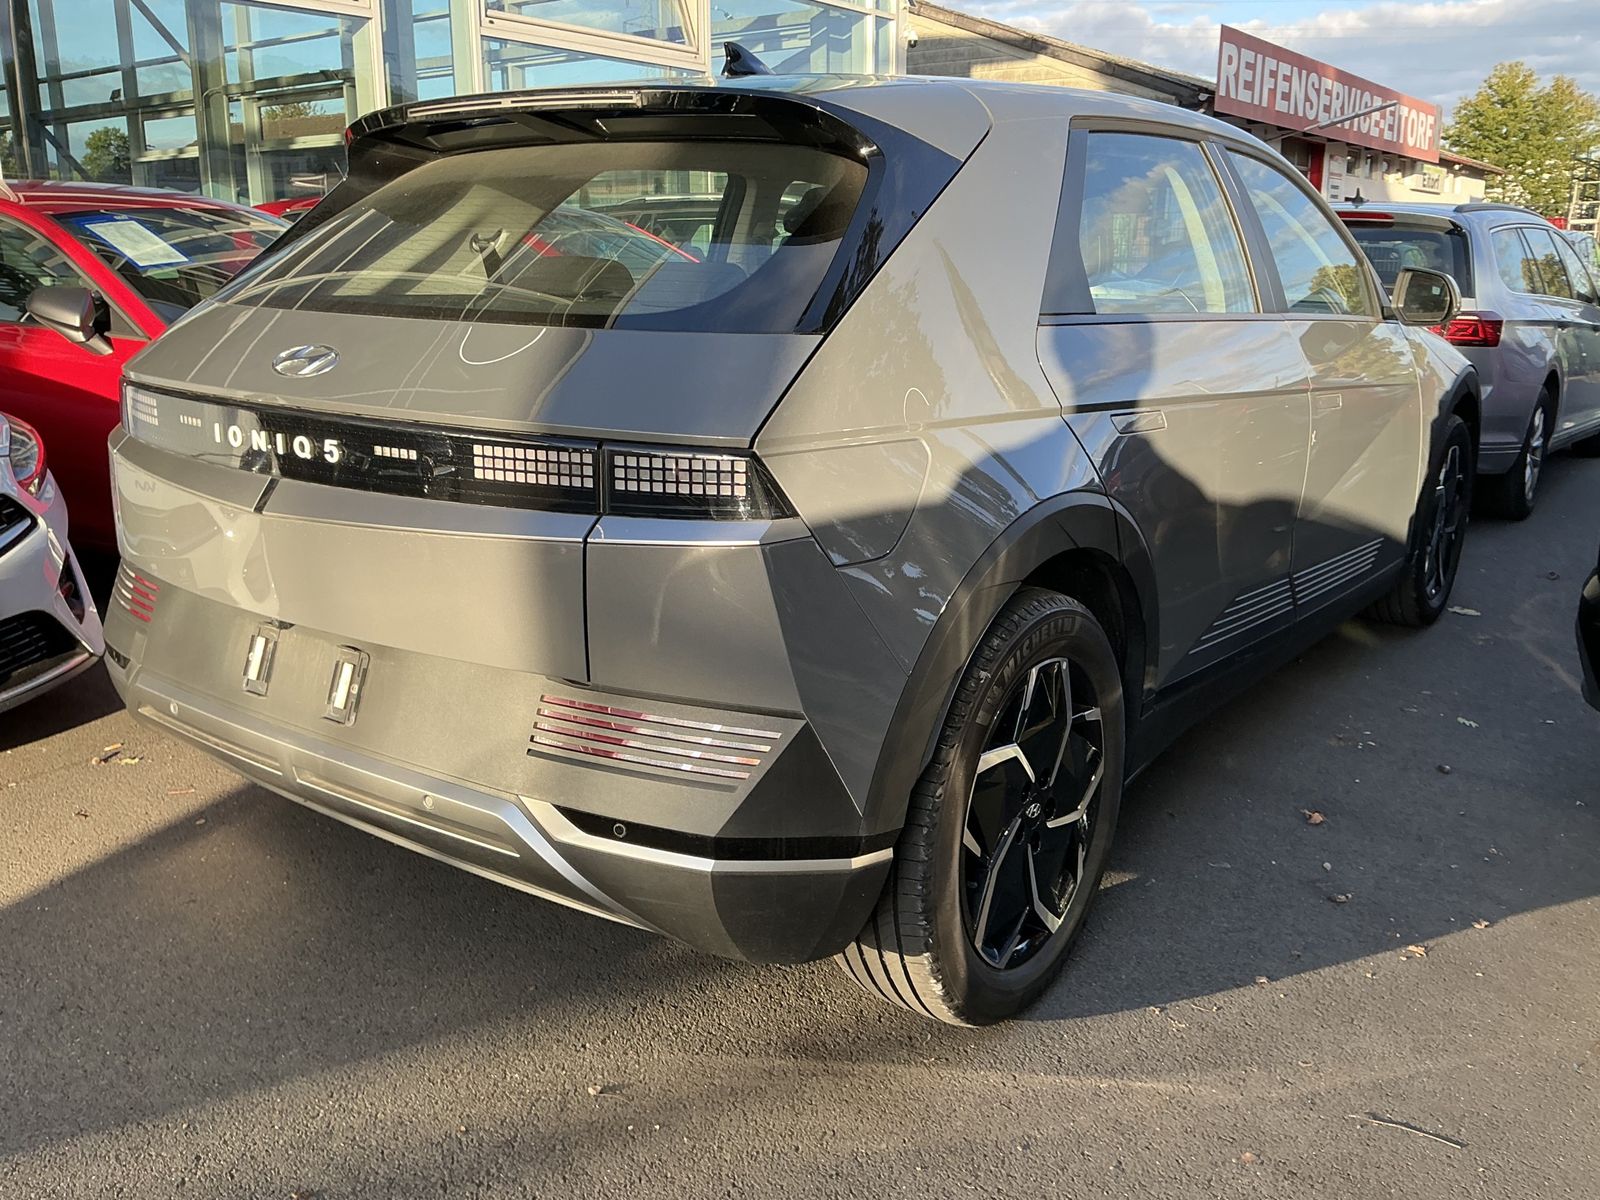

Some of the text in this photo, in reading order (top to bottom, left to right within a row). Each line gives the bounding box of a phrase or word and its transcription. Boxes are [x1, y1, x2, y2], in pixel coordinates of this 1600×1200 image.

[214, 422, 340, 463] IONIQ 5
[1003, 617, 1076, 686] MICHELIN
